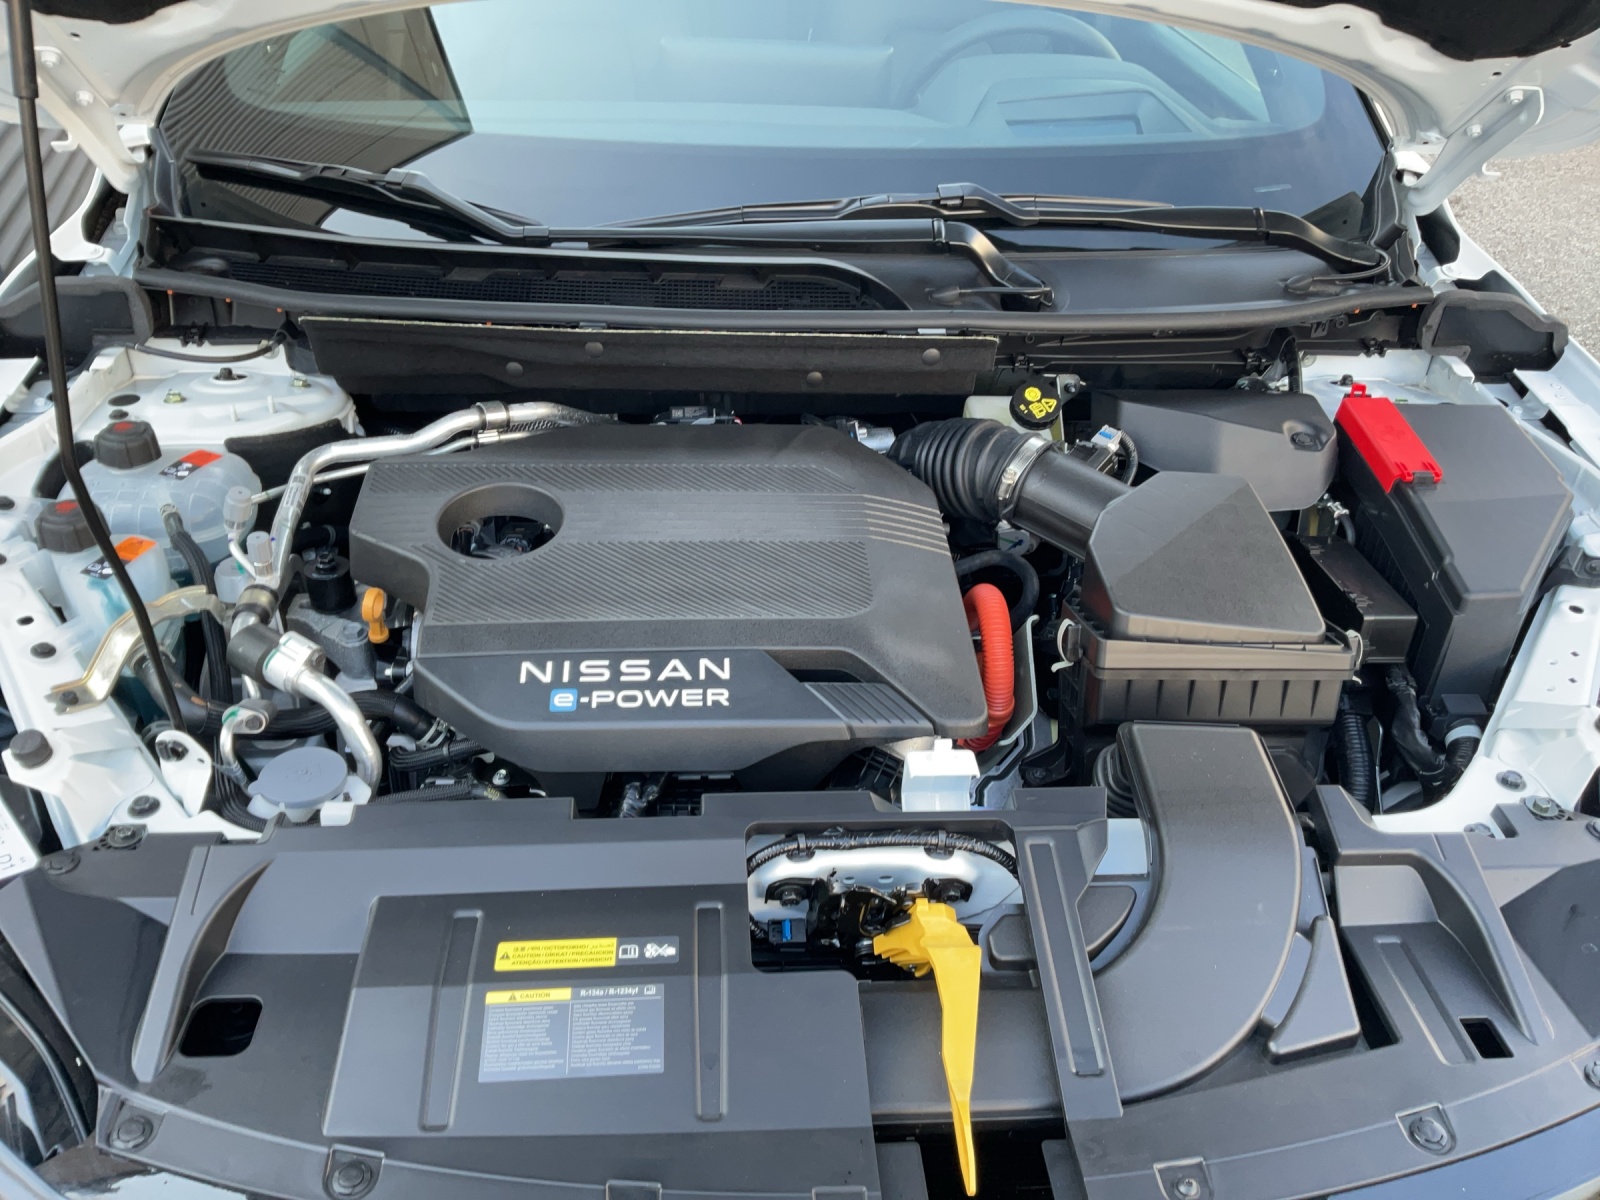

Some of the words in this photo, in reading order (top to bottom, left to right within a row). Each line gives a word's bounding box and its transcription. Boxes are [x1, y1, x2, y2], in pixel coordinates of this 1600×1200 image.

[519, 657, 731, 684] NISSAN
[552, 688, 730, 709] e-POWER
[520, 992, 551, 1000] CAUTION
[580, 988, 604, 997] R-134a
